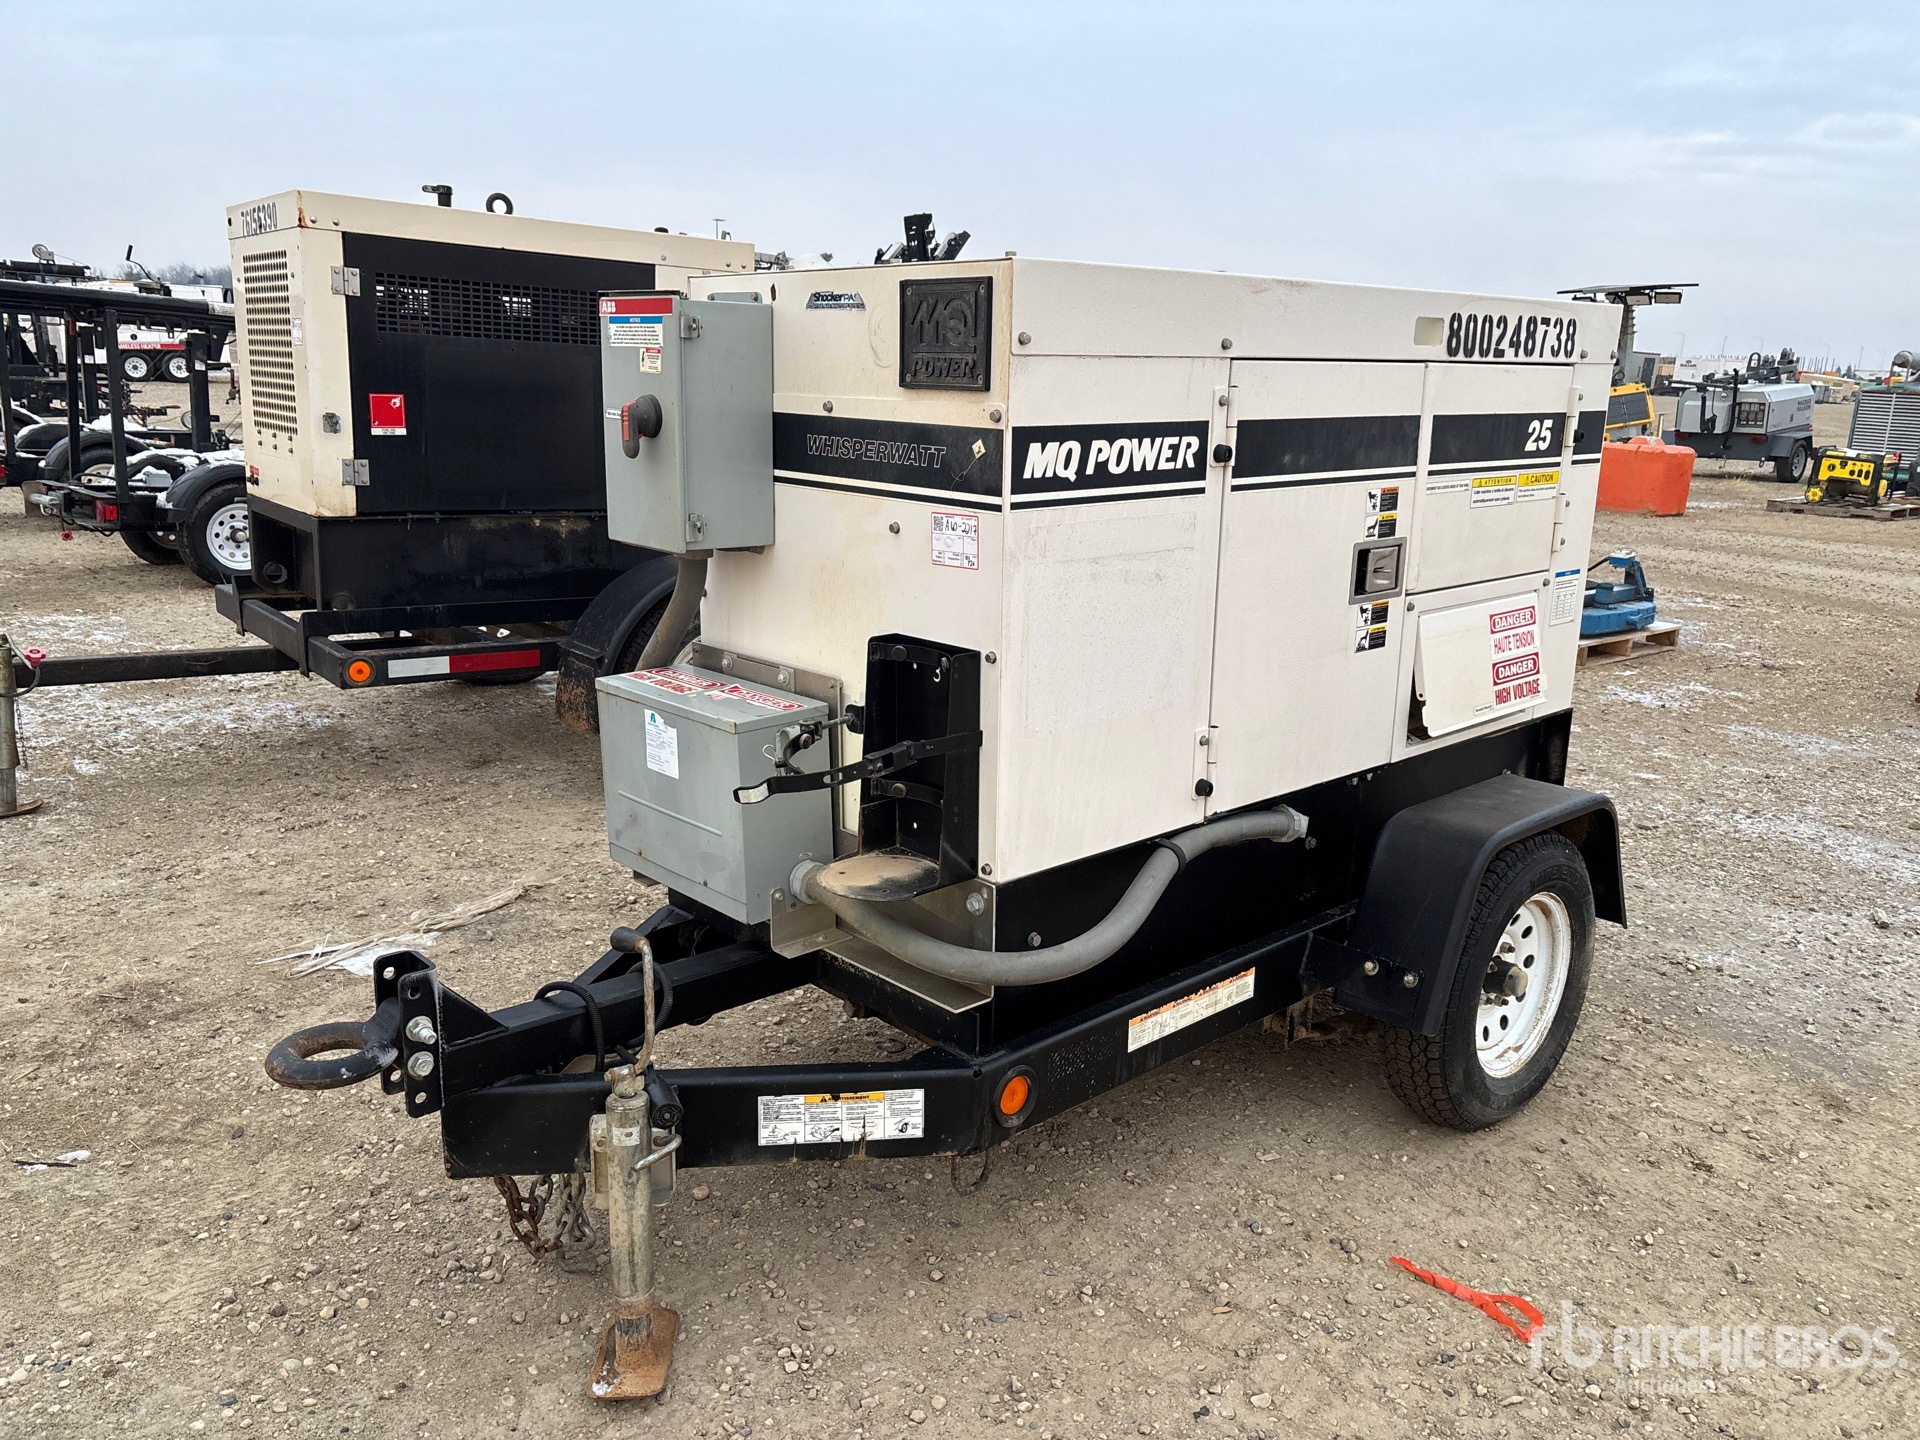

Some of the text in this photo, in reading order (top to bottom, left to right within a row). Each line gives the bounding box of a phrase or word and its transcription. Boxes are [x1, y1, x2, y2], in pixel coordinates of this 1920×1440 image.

[601, 301, 616, 313] ABB
[1447, 312, 1577, 359] 800248738
[911, 356, 976, 379] POWER
[1524, 419, 1553, 451] 25
[806, 433, 946, 469] WHISPERWATT
[1023, 435, 1200, 483] MQ POWER
[1484, 478, 1512, 486] ATTENTION
[1530, 474, 1554, 484] CAUTION
[1495, 611, 1531, 629] DANGER
[1493, 630, 1535, 655] HAUTE TENSION
[1498, 660, 1534, 679] DANGER
[1495, 678, 1540, 706] HIGH VOLTAGE
